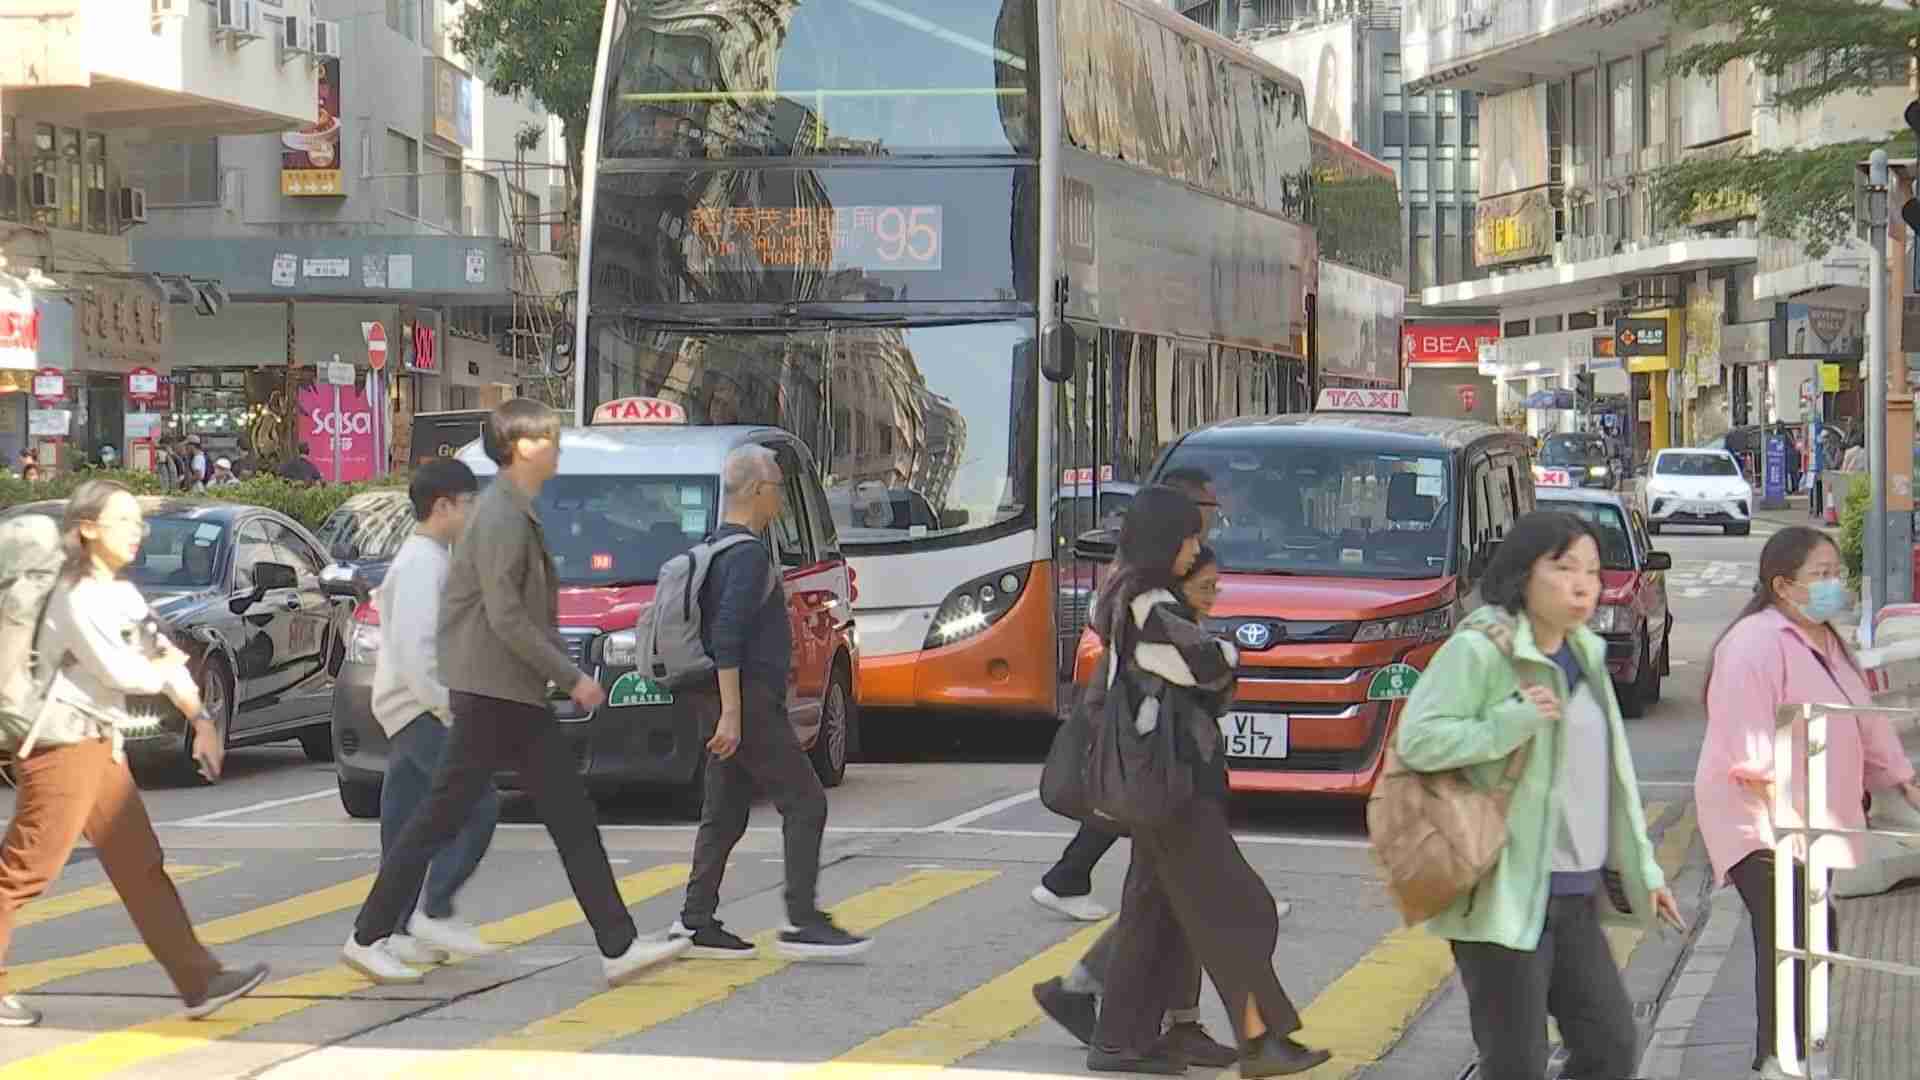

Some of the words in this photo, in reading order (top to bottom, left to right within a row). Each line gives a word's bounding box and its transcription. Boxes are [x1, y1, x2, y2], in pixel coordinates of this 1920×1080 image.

[875, 206, 937, 261] 95
[1423, 336, 1472, 353] BEA
[607, 399, 672, 418] TAXI
[1328, 389, 1398, 409] TAXI
[634, 679, 648, 693] 4
[1234, 715, 1265, 735] VL
